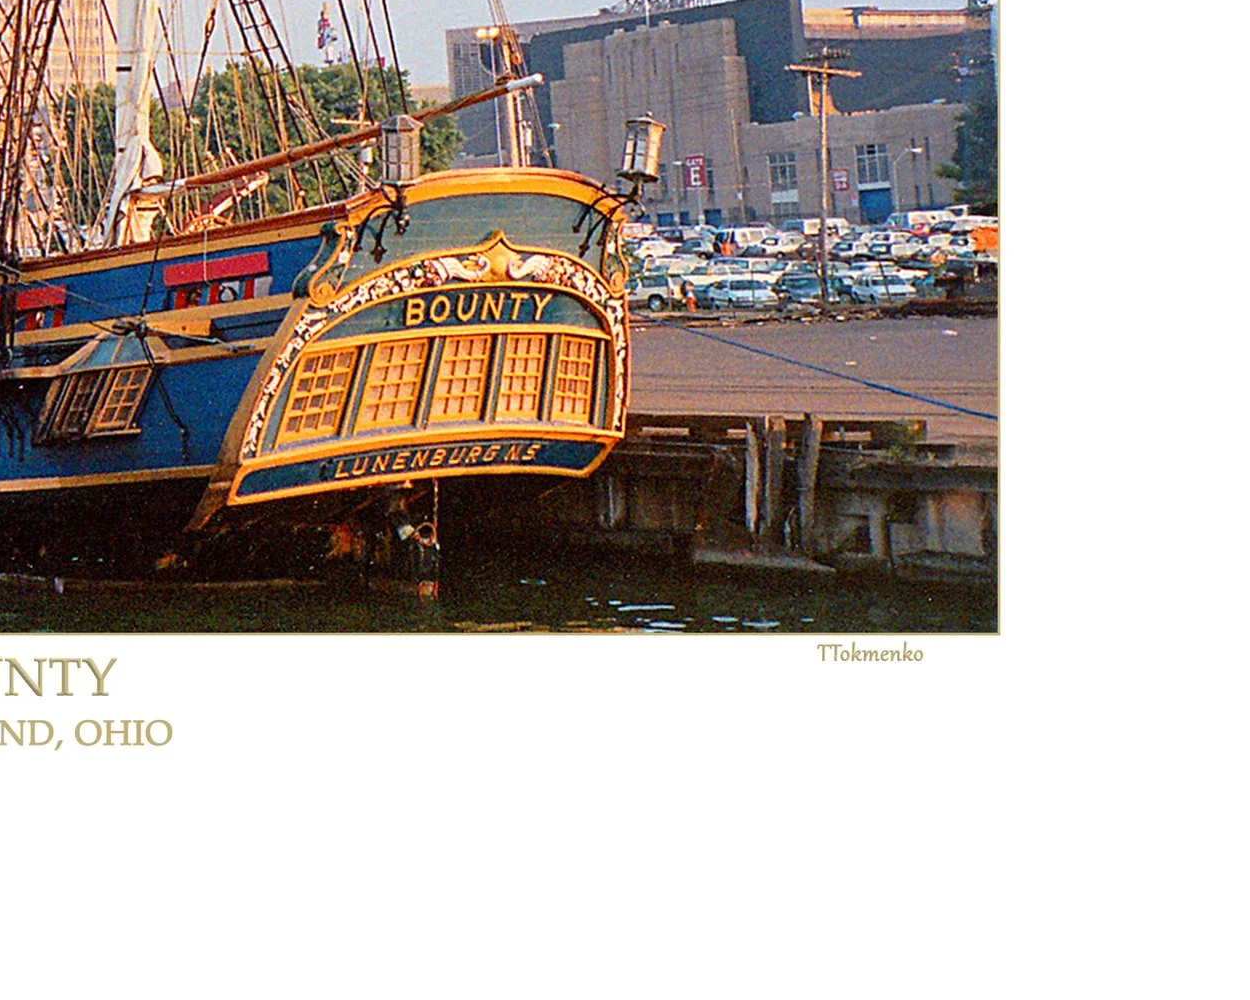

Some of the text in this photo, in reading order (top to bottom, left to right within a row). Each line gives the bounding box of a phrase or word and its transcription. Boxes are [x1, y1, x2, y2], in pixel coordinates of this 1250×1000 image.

[690, 166, 702, 186] E
[405, 293, 553, 327] BOUNTY
[335, 444, 501, 478] LUNENBURG
